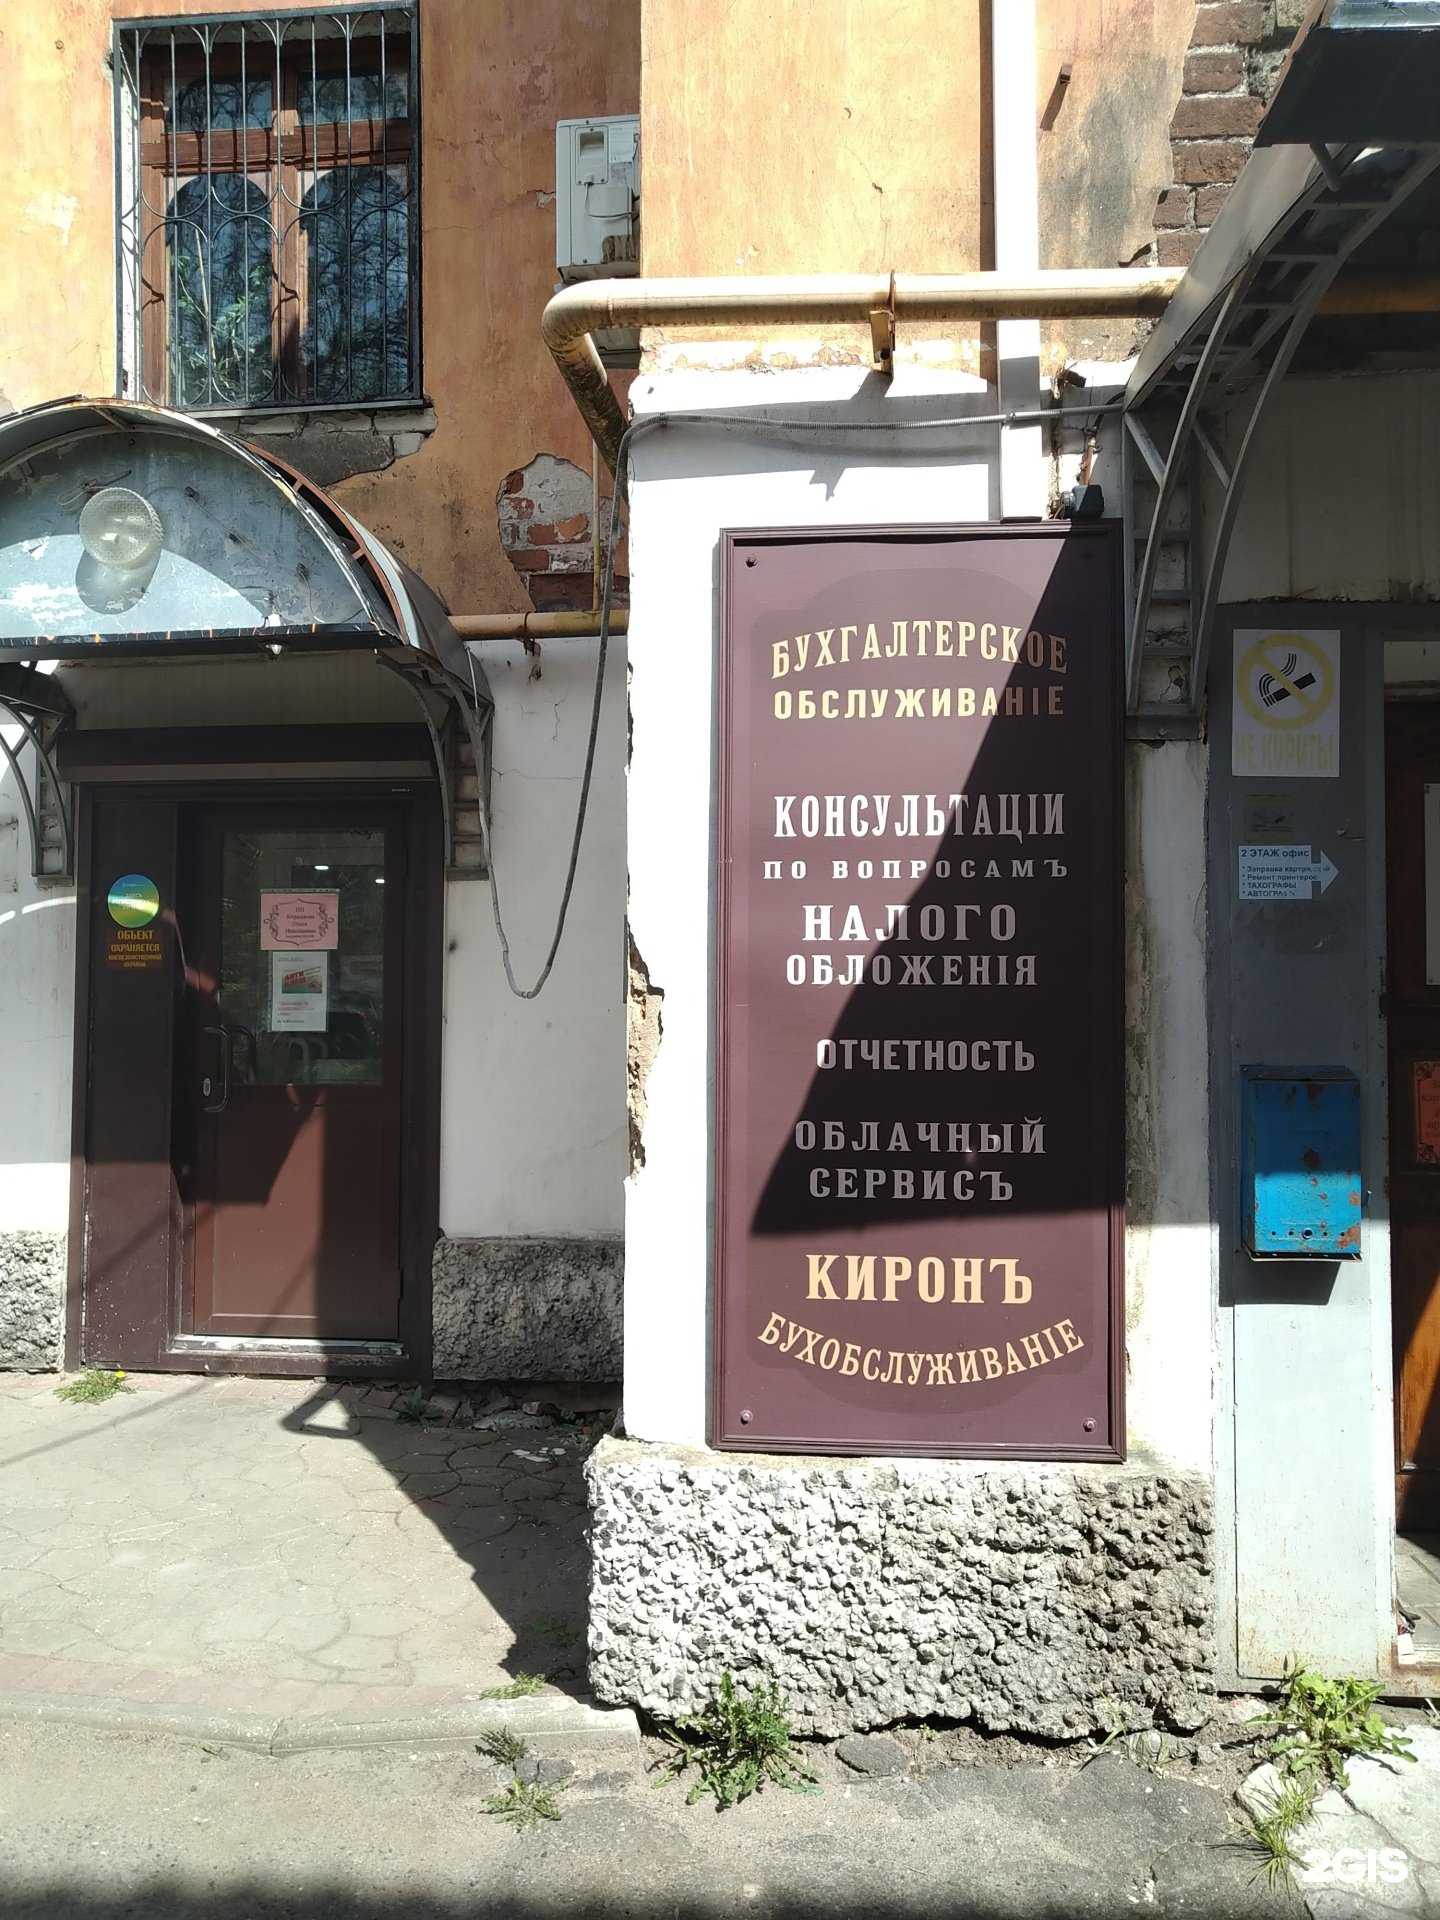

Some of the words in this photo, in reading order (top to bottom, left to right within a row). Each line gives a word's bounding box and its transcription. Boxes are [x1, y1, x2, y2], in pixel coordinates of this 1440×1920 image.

[770, 620, 1069, 680] БУХГАЛТЕРСКОЕ
[773, 686, 1065, 720] ОБСЛУЖИВАНІЕ
[773, 793, 1066, 845] КОНСУЛЬТАЦІИ
[762, 859, 808, 880] ПО
[831, 858, 1068, 879] ВОПРОСАМЪ
[1241, 848, 1248, 858] 2
[1249, 848, 1280, 858] ЭТАЖ
[1282, 848, 1310, 859] офис
[802, 903, 1017, 942] НАЛОГО
[786, 954, 1038, 987] ОБЛОЖЕНІЯ
[816, 1039, 1036, 1072] ОТЧЕТНОСТЬ
[795, 1117, 1047, 1154] ОБЛАЧНЫЙ
[809, 1168, 1014, 1202] СЕРВИСЪ
[806, 1254, 1033, 1304] КИРОНЪ
[757, 1311, 1086, 1386] БУХОБСЛУЖИВАНІЕ
